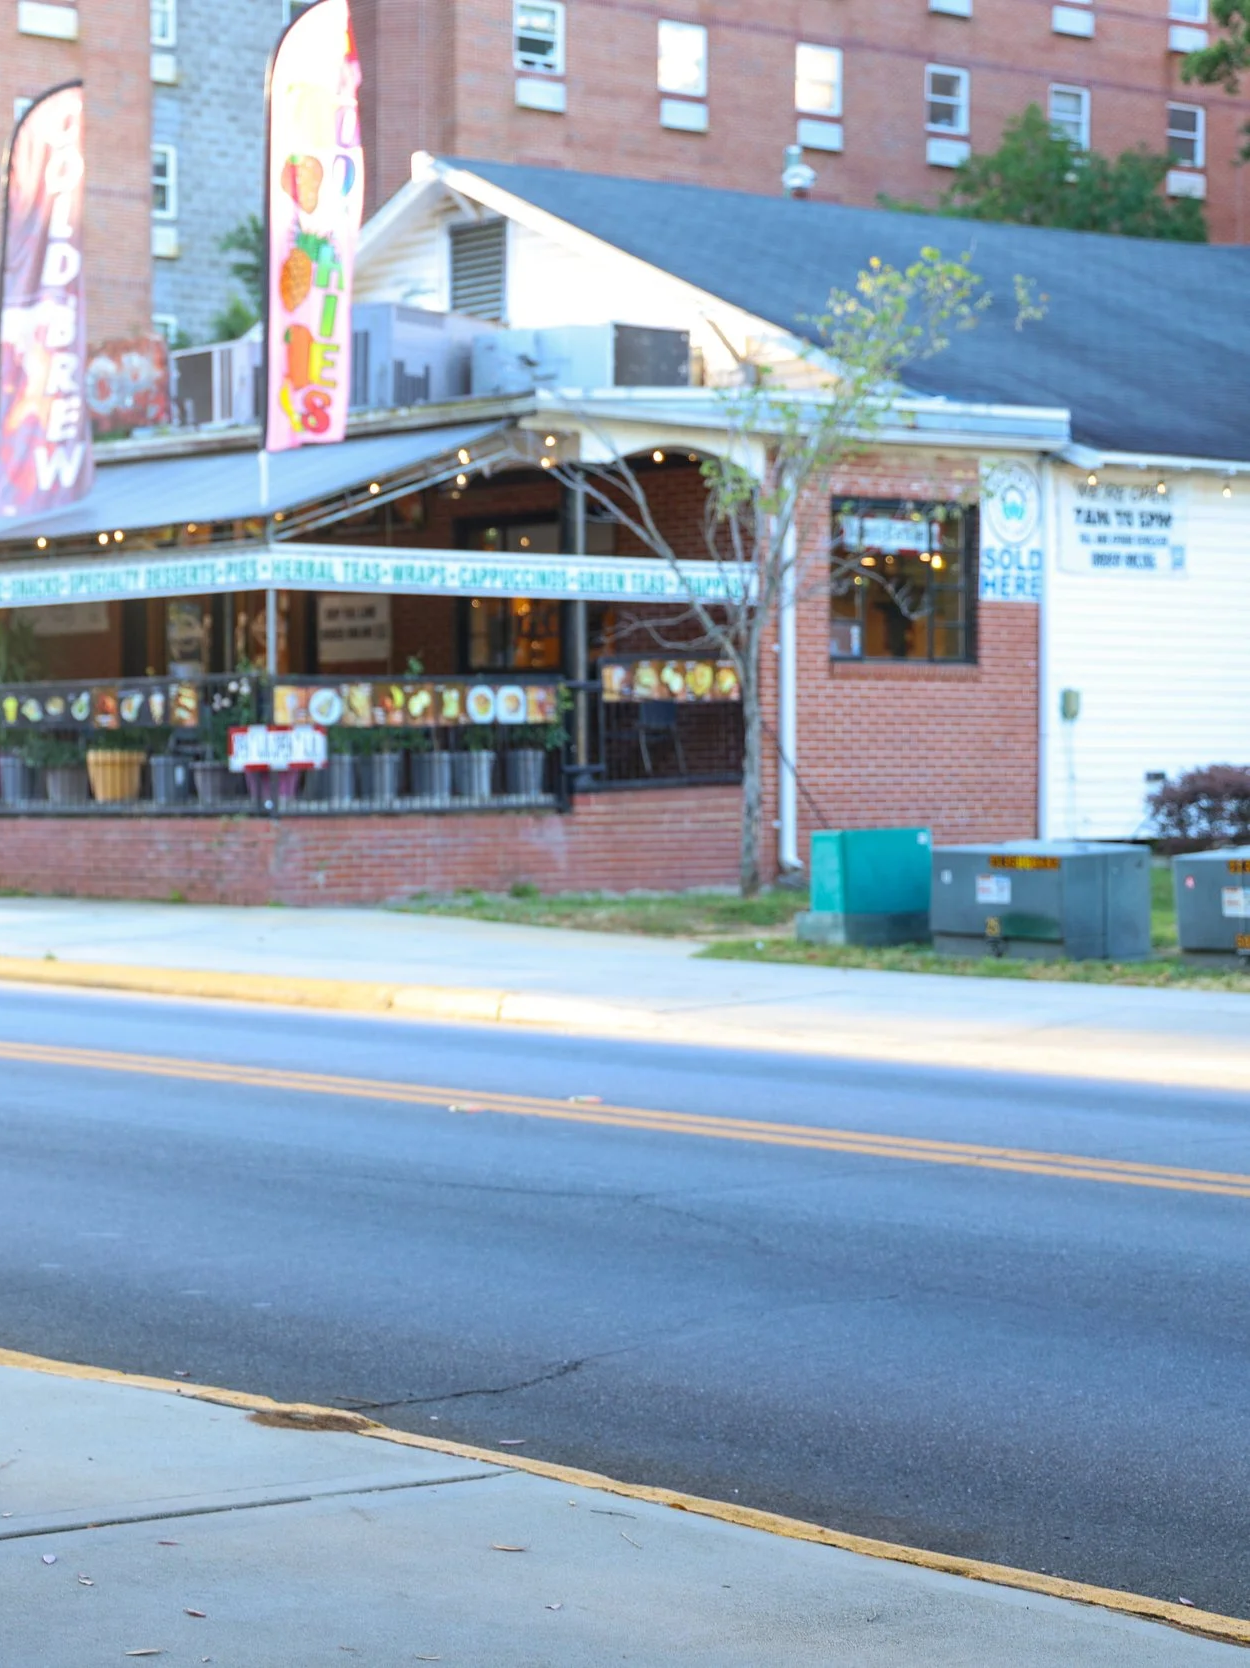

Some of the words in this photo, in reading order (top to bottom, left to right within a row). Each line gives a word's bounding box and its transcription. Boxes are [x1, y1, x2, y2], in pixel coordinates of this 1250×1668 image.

[42, 92, 85, 286] COLD
[34, 298, 85, 491] BREW
[146, 562, 215, 588] DESSERTS
[226, 558, 257, 582] PIES
[272, 557, 334, 582] HERBAL
[343, 561, 381, 584] TEAS
[392, 563, 446, 586] WRAPS
[578, 570, 625, 592] GREEN
[632, 572, 665, 594] TEAS
[981, 548, 1043, 571] SOLD
[980, 575, 1043, 597] HERE
